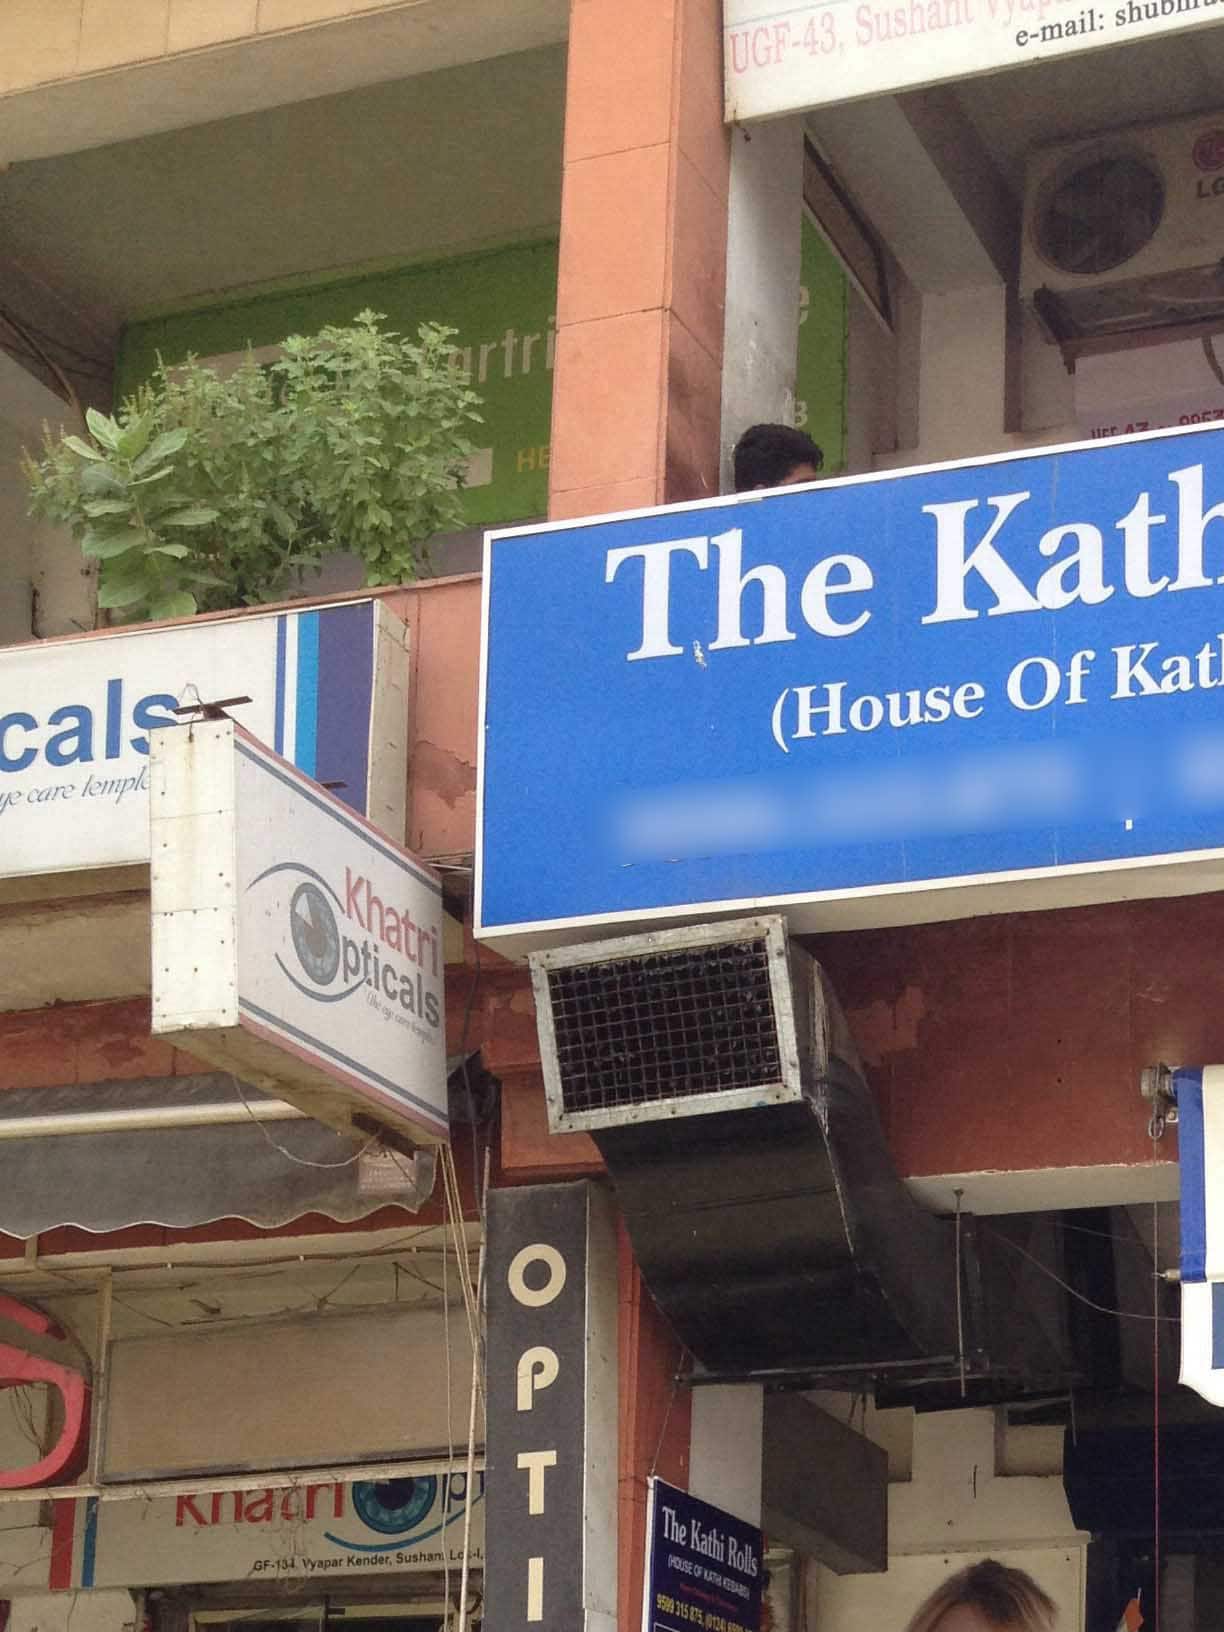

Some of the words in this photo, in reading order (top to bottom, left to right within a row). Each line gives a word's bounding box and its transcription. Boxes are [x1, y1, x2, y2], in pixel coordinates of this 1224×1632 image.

[1015, 8, 1105, 47] e-mail:
[605, 527, 874, 662] The
[772, 680, 986, 753] (House
[1007, 650, 1095, 712] Of
[27, 784, 76, 803] care
[344, 865, 439, 978] Khatri
[662, 1506, 687, 1547] The
[690, 1519, 725, 1562] Kathi
[728, 1536, 758, 1578] Rolls
